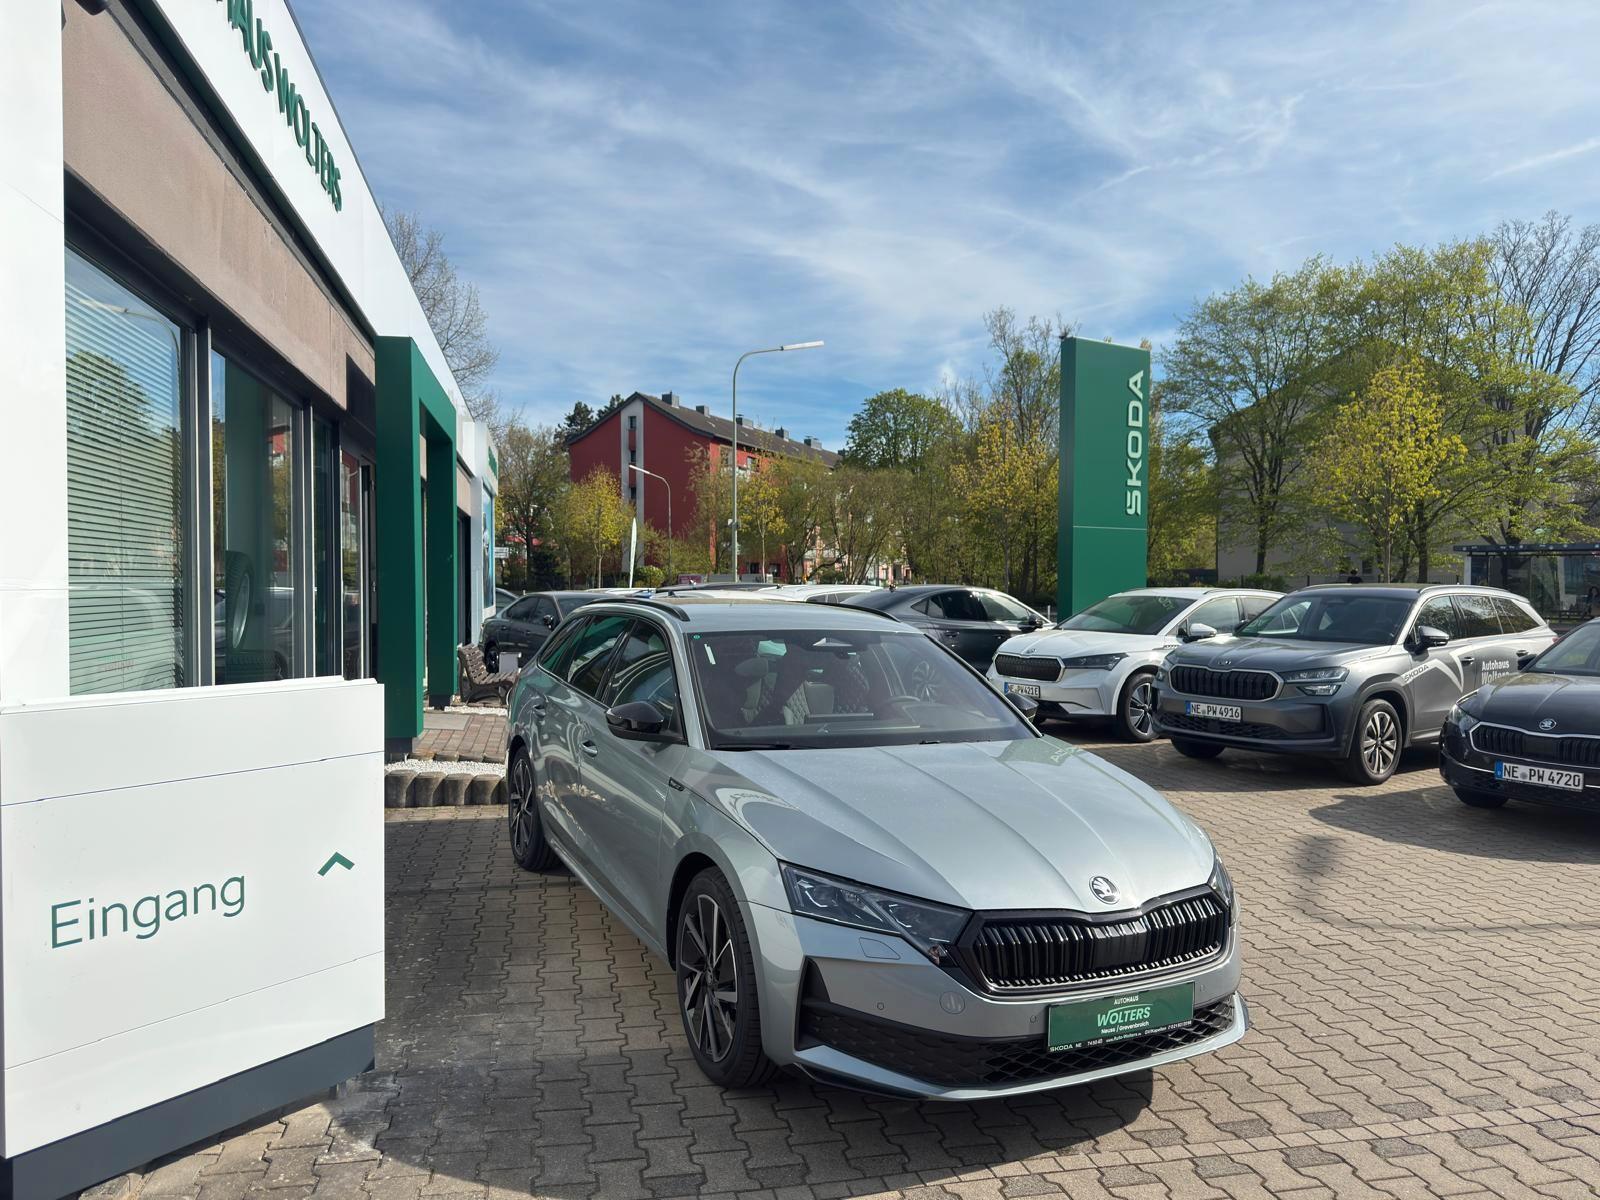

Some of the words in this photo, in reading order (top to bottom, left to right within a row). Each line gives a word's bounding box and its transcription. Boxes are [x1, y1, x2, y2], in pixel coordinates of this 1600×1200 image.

[273, 53, 342, 213] WOLTERS
[1481, 660, 1510, 671] Autohaus
[1191, 703, 1201, 714] NE
[1207, 705, 1217, 716] PW
[1219, 706, 1240, 718] 4916
[1503, 765, 1518, 779] NE
[1528, 768, 1545, 782] PW
[1548, 771, 1580, 787] 4720
[51, 875, 245, 949] Eingang
[1113, 995, 1139, 1005] AUTOHAUS
[1097, 1005, 1151, 1027] WOLTERS
